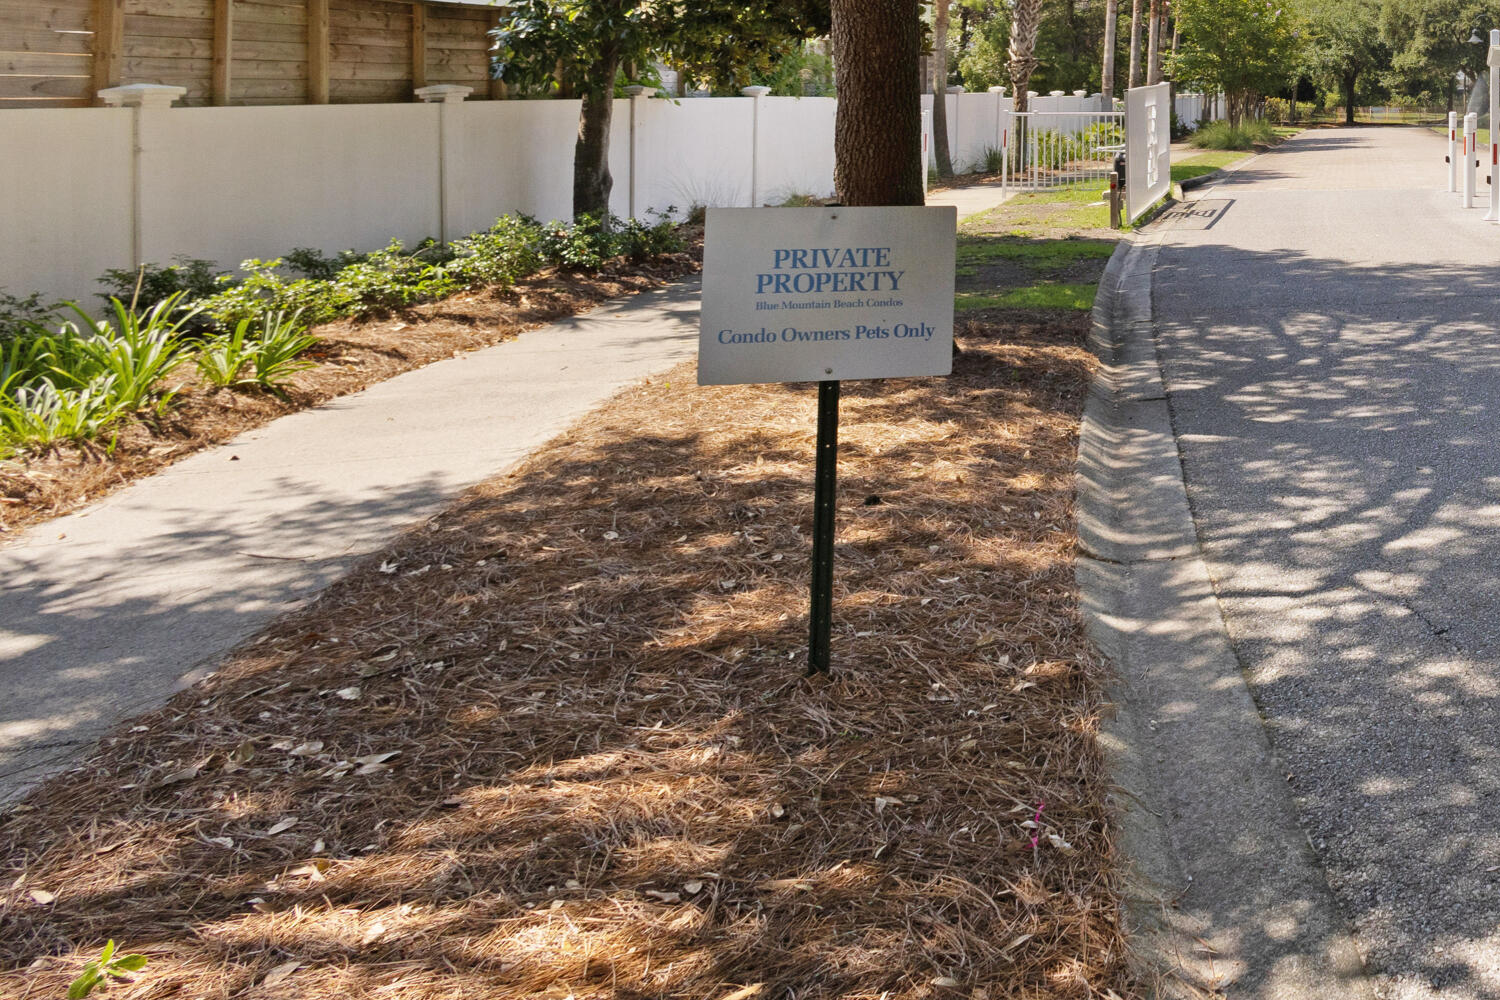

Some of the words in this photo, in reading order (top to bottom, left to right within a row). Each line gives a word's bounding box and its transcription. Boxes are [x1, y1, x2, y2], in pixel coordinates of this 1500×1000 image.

[773, 248, 891, 269] PRIVATE
[755, 271, 905, 294] PROPERTY
[755, 301, 779, 311] Blue
[781, 299, 831, 310] Mountain
[833, 299, 864, 309] Beach
[866, 297, 903, 308] Condos
[718, 328, 777, 345] Condo
[781, 327, 850, 342] Owners
[855, 325, 890, 340] Pets
[893, 322, 936, 342] Only
